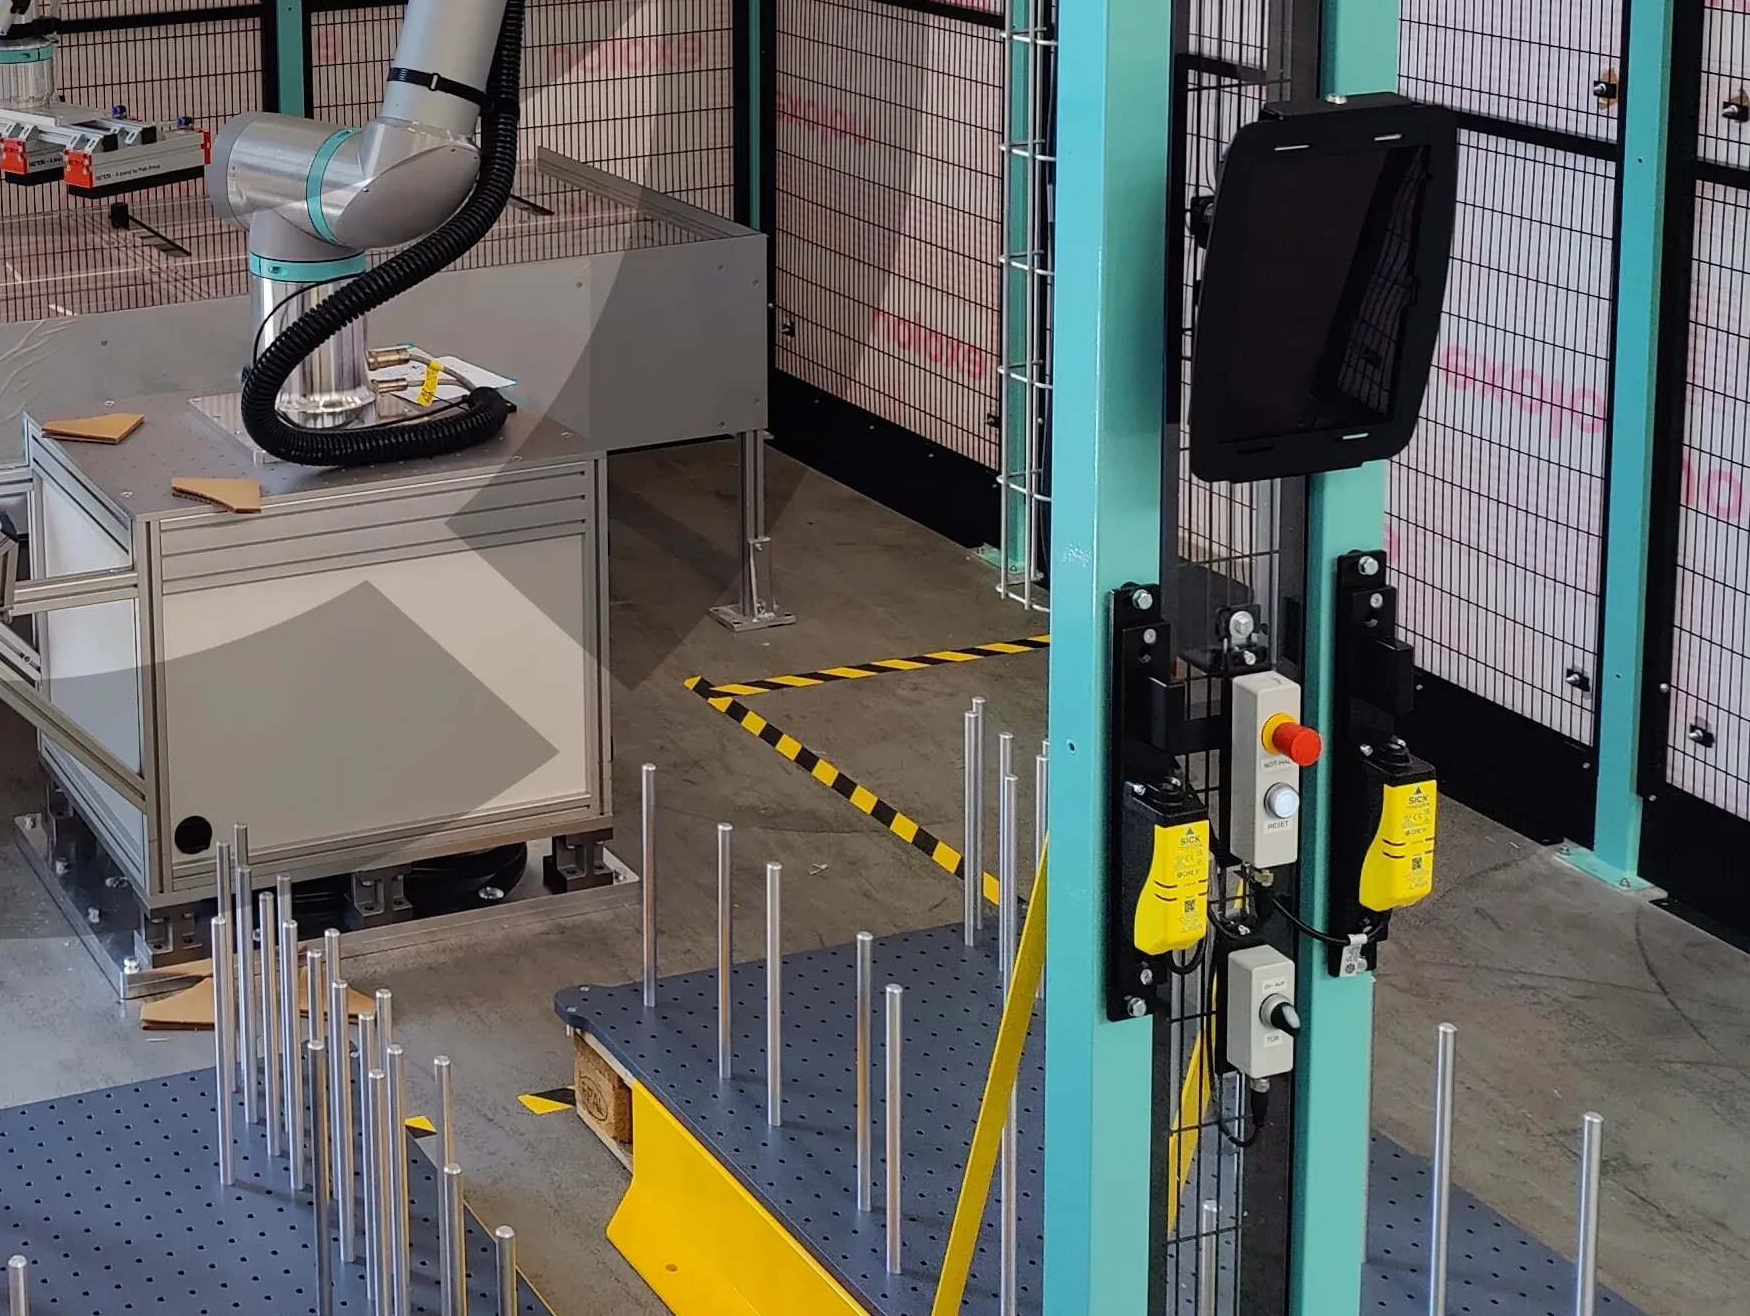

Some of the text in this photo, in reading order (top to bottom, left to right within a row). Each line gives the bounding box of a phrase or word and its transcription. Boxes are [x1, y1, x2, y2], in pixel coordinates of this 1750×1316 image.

[1408, 794, 1429, 805] SICK
[1267, 820, 1289, 831] RESET
[1180, 834, 1201, 846] SICK
